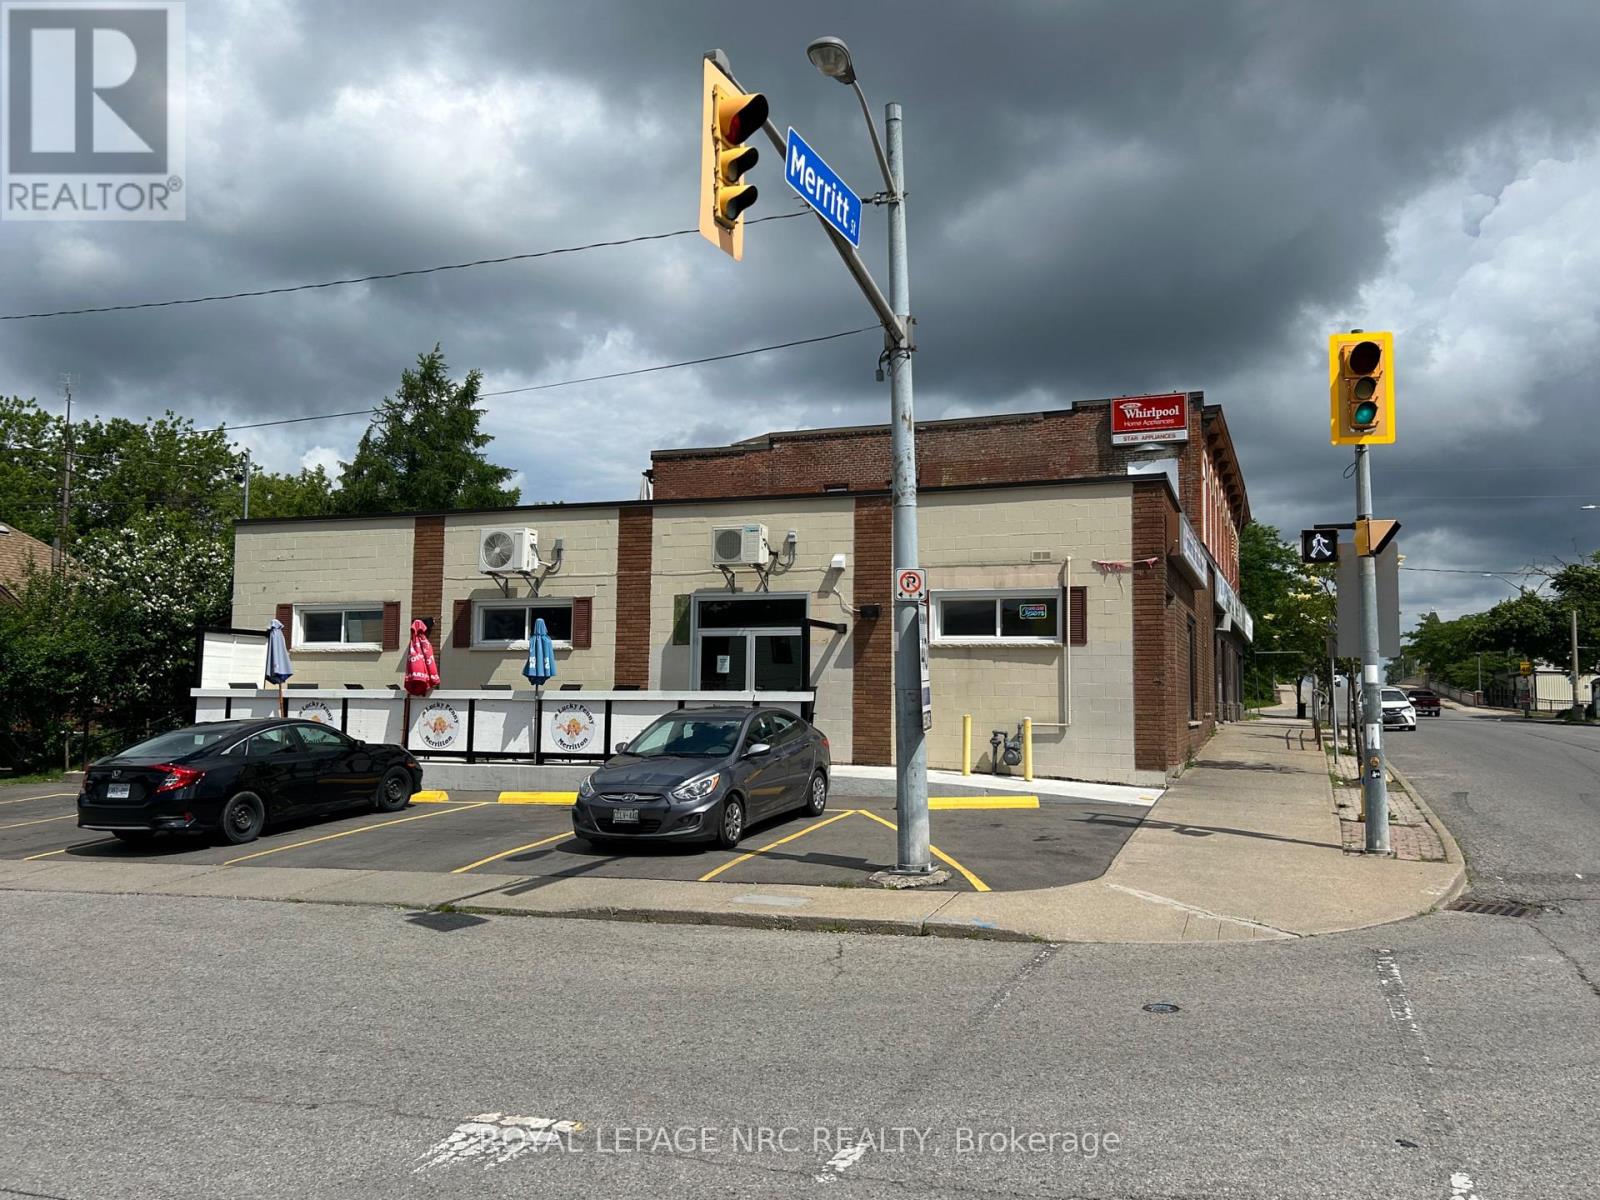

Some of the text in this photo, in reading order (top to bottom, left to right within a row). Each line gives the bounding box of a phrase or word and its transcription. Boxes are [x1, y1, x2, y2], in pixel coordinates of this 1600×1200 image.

[791, 144, 849, 228] Merritt
[1124, 405, 1180, 419] Whirlpool
[1143, 418, 1174, 426] Appliances
[425, 702, 459, 723] Lucky Penny
[557, 702, 594, 724] Lucky Penny
[424, 735, 453, 747] Merritton
[558, 738, 588, 750] Merritton
